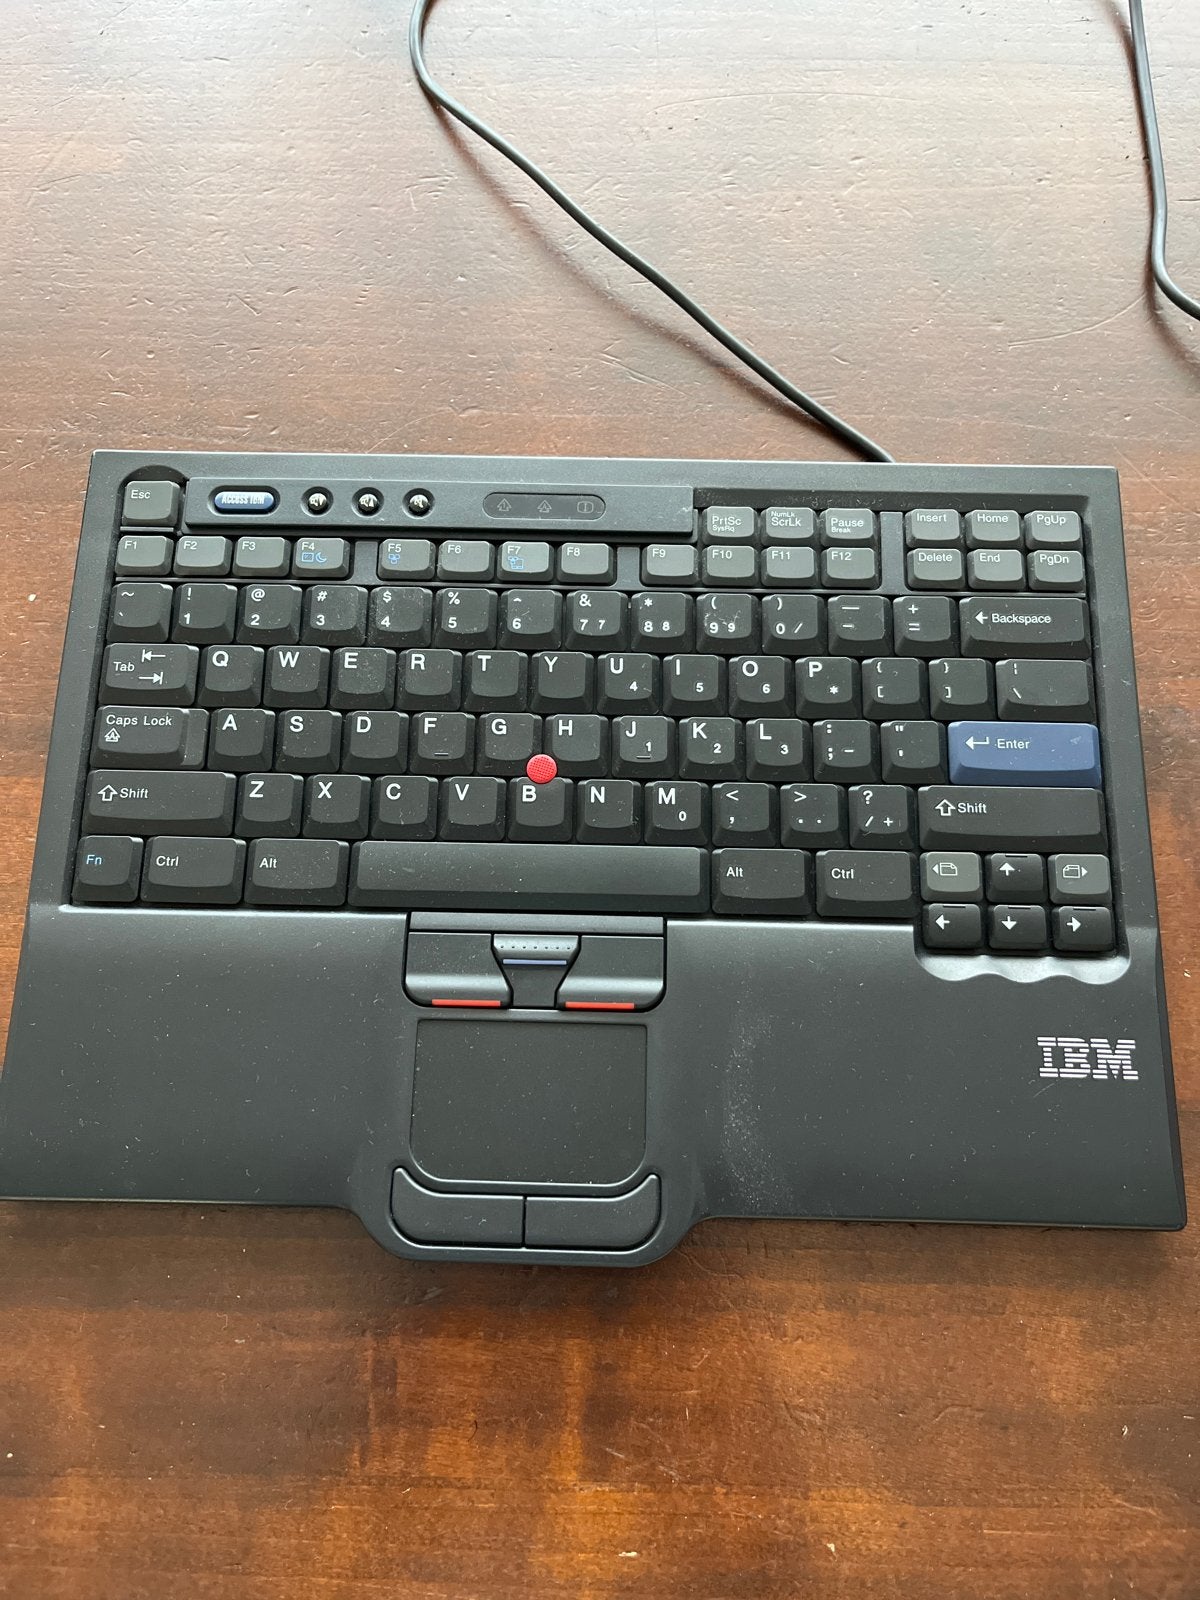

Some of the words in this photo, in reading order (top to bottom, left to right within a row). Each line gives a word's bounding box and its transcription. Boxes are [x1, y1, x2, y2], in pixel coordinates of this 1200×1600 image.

[130, 490, 151, 500] Esc
[712, 515, 742, 526] PrtSc
[770, 510, 795, 518] NumLk
[916, 512, 947, 523] Insert
[977, 513, 1009, 523] Home
[1036, 513, 1067, 526] PgUp
[712, 524, 735, 533] SysRq
[771, 517, 802, 527] ScrLk
[830, 517, 865, 528] Pause
[831, 526, 852, 534] Break
[124, 540, 137, 550] F1
[183, 540, 198, 550] F2
[241, 540, 256, 551] F3
[301, 541, 315, 551] F4
[387, 542, 402, 553] F5
[447, 544, 462, 554] F6
[507, 545, 522, 555] F7
[566, 546, 581, 557] F8
[652, 547, 666, 558] F9
[712, 549, 733, 560] F10
[771, 550, 791, 560] F11
[831, 550, 852, 561] F12
[918, 551, 953, 562] Delete
[979, 552, 1001, 563] End
[1039, 553, 1070, 566] PgDn
[183, 612, 191, 625] 1
[250, 613, 260, 626] 2
[315, 614, 326, 626] 3
[380, 615, 391, 628] 4
[447, 616, 458, 629] 5
[512, 617, 522, 630] 6
[579, 618, 589, 631] 7
[598, 619, 606, 630] 7
[991, 613, 1052, 626] Backspace
[643, 620, 654, 633] 8
[662, 620, 671, 632] 8
[709, 621, 719, 634] 9
[727, 622, 736, 633] 9
[775, 622, 786, 635] 0
[212, 650, 229, 667] Q
[278, 650, 300, 668] W
[343, 651, 359, 669] E
[410, 653, 426, 671] R
[477, 654, 492, 672] T
[543, 655, 559, 673] Y
[113, 661, 135, 672] Tab
[610, 657, 624, 675] U
[675, 658, 681, 676] I
[742, 660, 759, 677] O
[808, 661, 823, 678] P
[629, 680, 638, 692] 4
[695, 682, 704, 693] 5
[762, 683, 771, 694] 6
[105, 714, 138, 728] Caps
[143, 715, 172, 726] Lock
[221, 713, 238, 731] A
[289, 715, 304, 733] S
[356, 715, 372, 733] D
[423, 717, 438, 734] F
[491, 718, 507, 735] G
[558, 719, 573, 736] H
[625, 720, 637, 738] J
[692, 722, 708, 740] K
[759, 723, 772, 740] L
[645, 741, 652, 752] 1
[713, 742, 722, 754] 2
[780, 744, 789, 755] 3
[997, 738, 1031, 750] Enter
[119, 787, 149, 799] Shift
[249, 780, 265, 798] Z
[317, 781, 333, 799] X
[385, 782, 401, 800] C
[454, 783, 470, 801] V
[522, 784, 537, 802] B
[590, 785, 606, 804] N
[658, 787, 676, 805] M
[957, 802, 987, 814] Shift
[678, 810, 687, 822] 0
[86, 854, 102, 865] Fn
[155, 855, 179, 867] Ctrl
[259, 857, 278, 869] Alt
[726, 866, 744, 878] Alt
[831, 867, 854, 880] Ctrl
[1036, 1036, 1139, 1080] IBM
